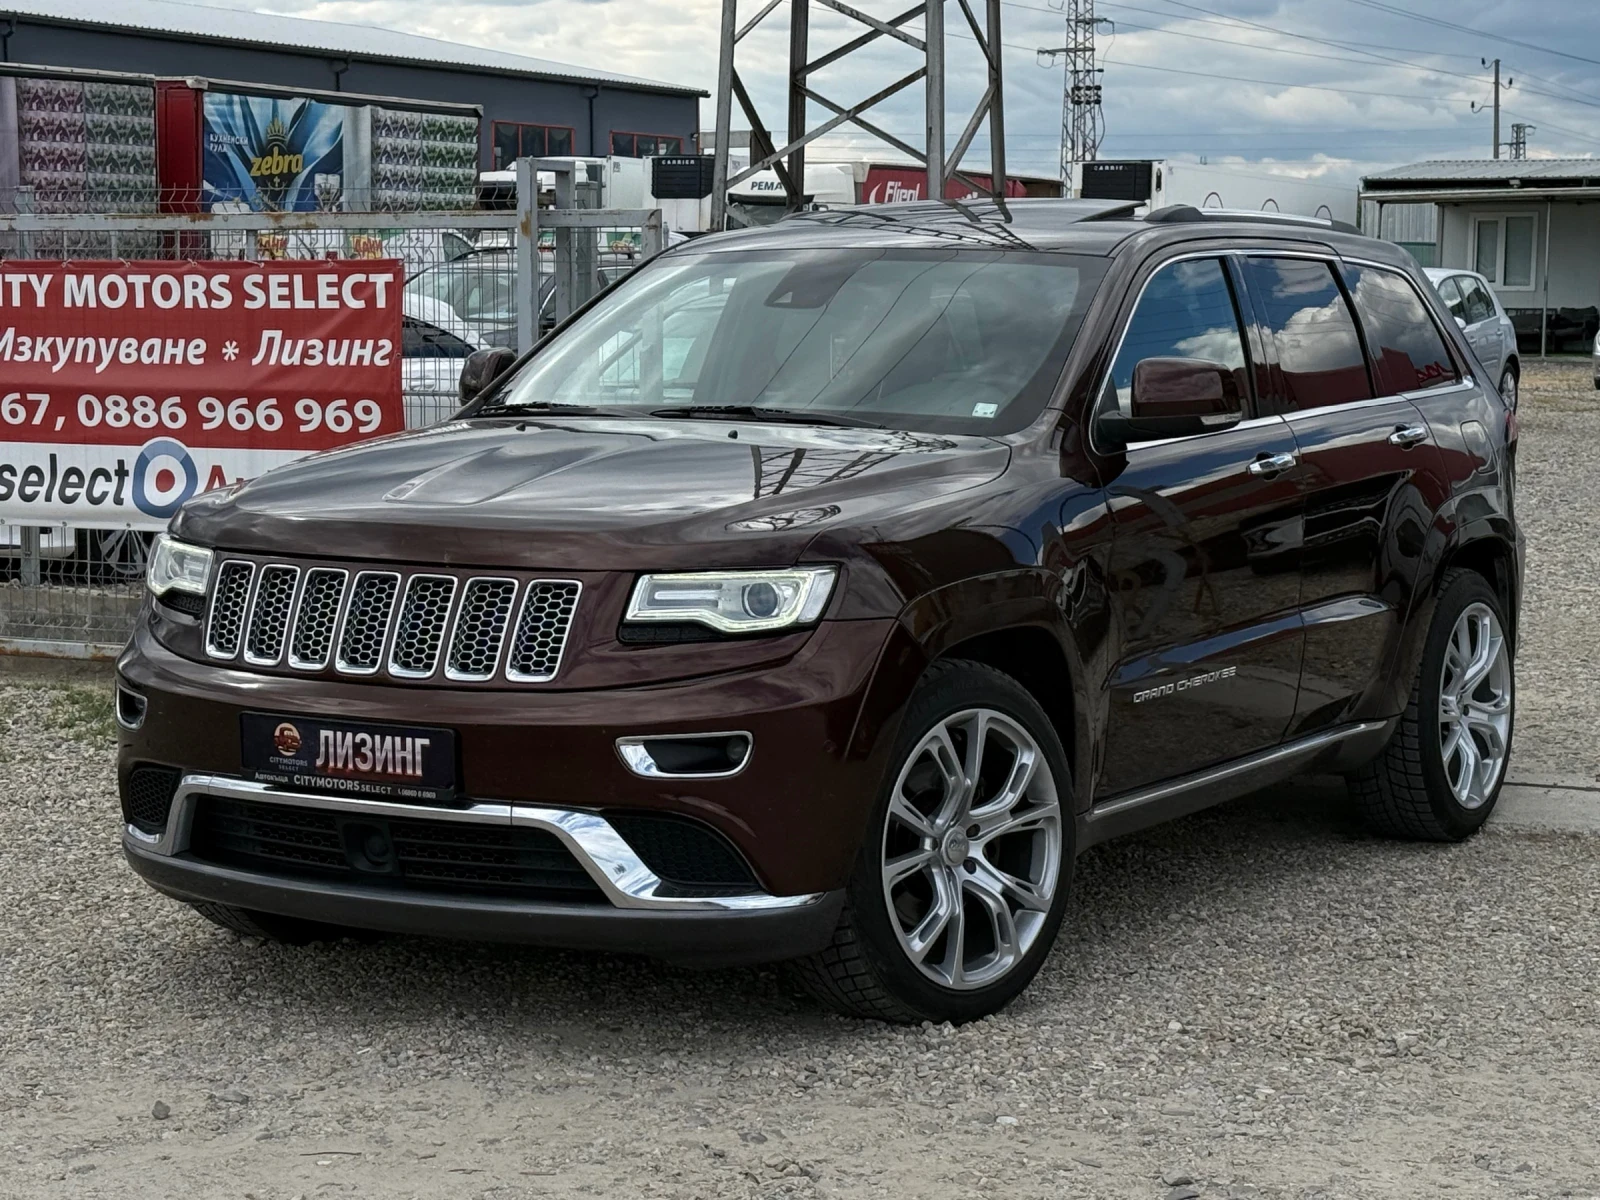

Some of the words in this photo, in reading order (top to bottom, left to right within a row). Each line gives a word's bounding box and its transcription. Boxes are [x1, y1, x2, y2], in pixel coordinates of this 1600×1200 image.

[250, 147, 303, 176] zebra
[750, 181, 783, 191] PEMA
[63, 274, 234, 310] MOTORS
[243, 274, 394, 309] SELECT
[251, 329, 393, 367] Лизинг
[77, 394, 188, 430] 0886
[197, 396, 284, 432] 966
[294, 398, 382, 434] 969
[0, 453, 129, 506] select
[1133, 683, 1174, 703] GRAND
[1176, 666, 1236, 691] CHEROKEE
[269, 756, 308, 767] CITYMOTORS
[315, 729, 430, 777] ЛИЗИНГ
[293, 774, 360, 791] CITYMOTORS
[361, 784, 392, 795] SELECT
